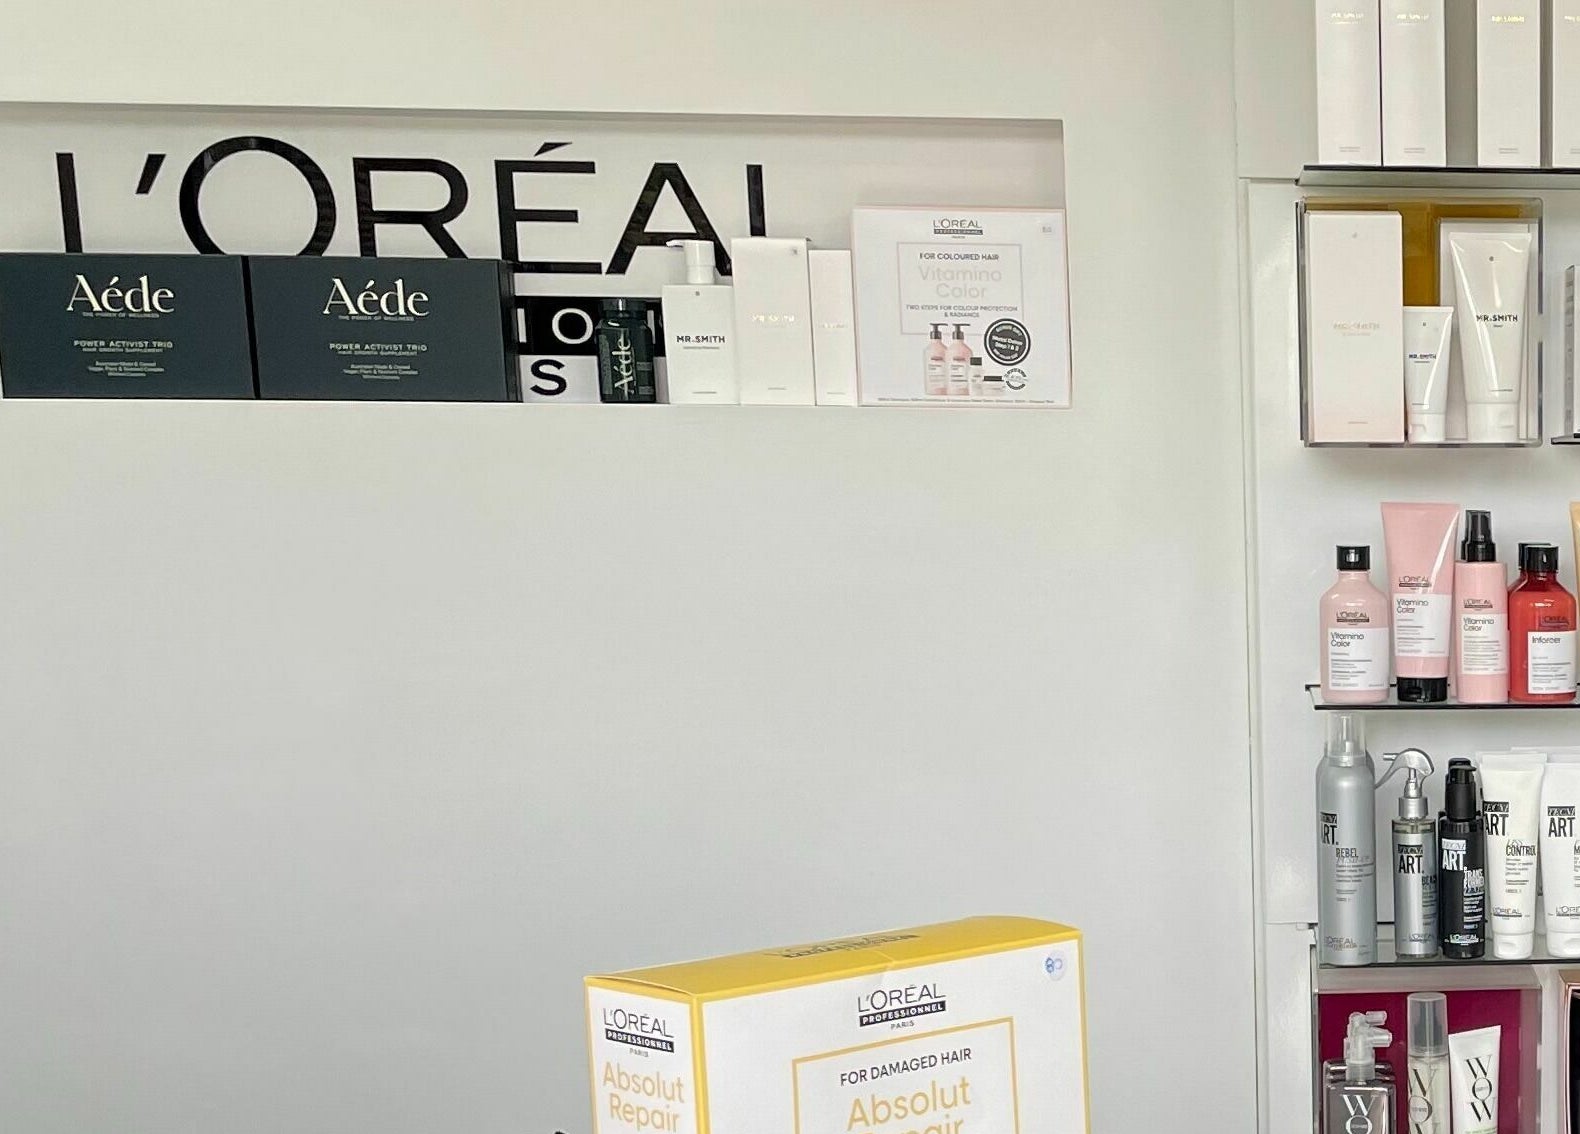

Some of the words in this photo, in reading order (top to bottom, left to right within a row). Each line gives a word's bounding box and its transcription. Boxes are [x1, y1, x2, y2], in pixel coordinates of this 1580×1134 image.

[66, 275, 175, 312] Aéde
[323, 278, 430, 316] Aéde
[73, 340, 106, 348] POWER
[857, 982, 947, 1013] L'ORÉAL
[861, 1002, 944, 1026] PROFESSIONNEL
[602, 1007, 674, 1039] L'ORÉAL
[889, 1020, 915, 1031] PARIS
[606, 1030, 673, 1052] PROFESSIONNEL
[602, 1061, 685, 1104] Absolut
[839, 1068, 868, 1086] FOR
[870, 1054, 938, 1081] DAMAGED
[940, 1047, 972, 1065] HAIR
[608, 1093, 680, 1133] Repair
[846, 1075, 972, 1132] Absolut
